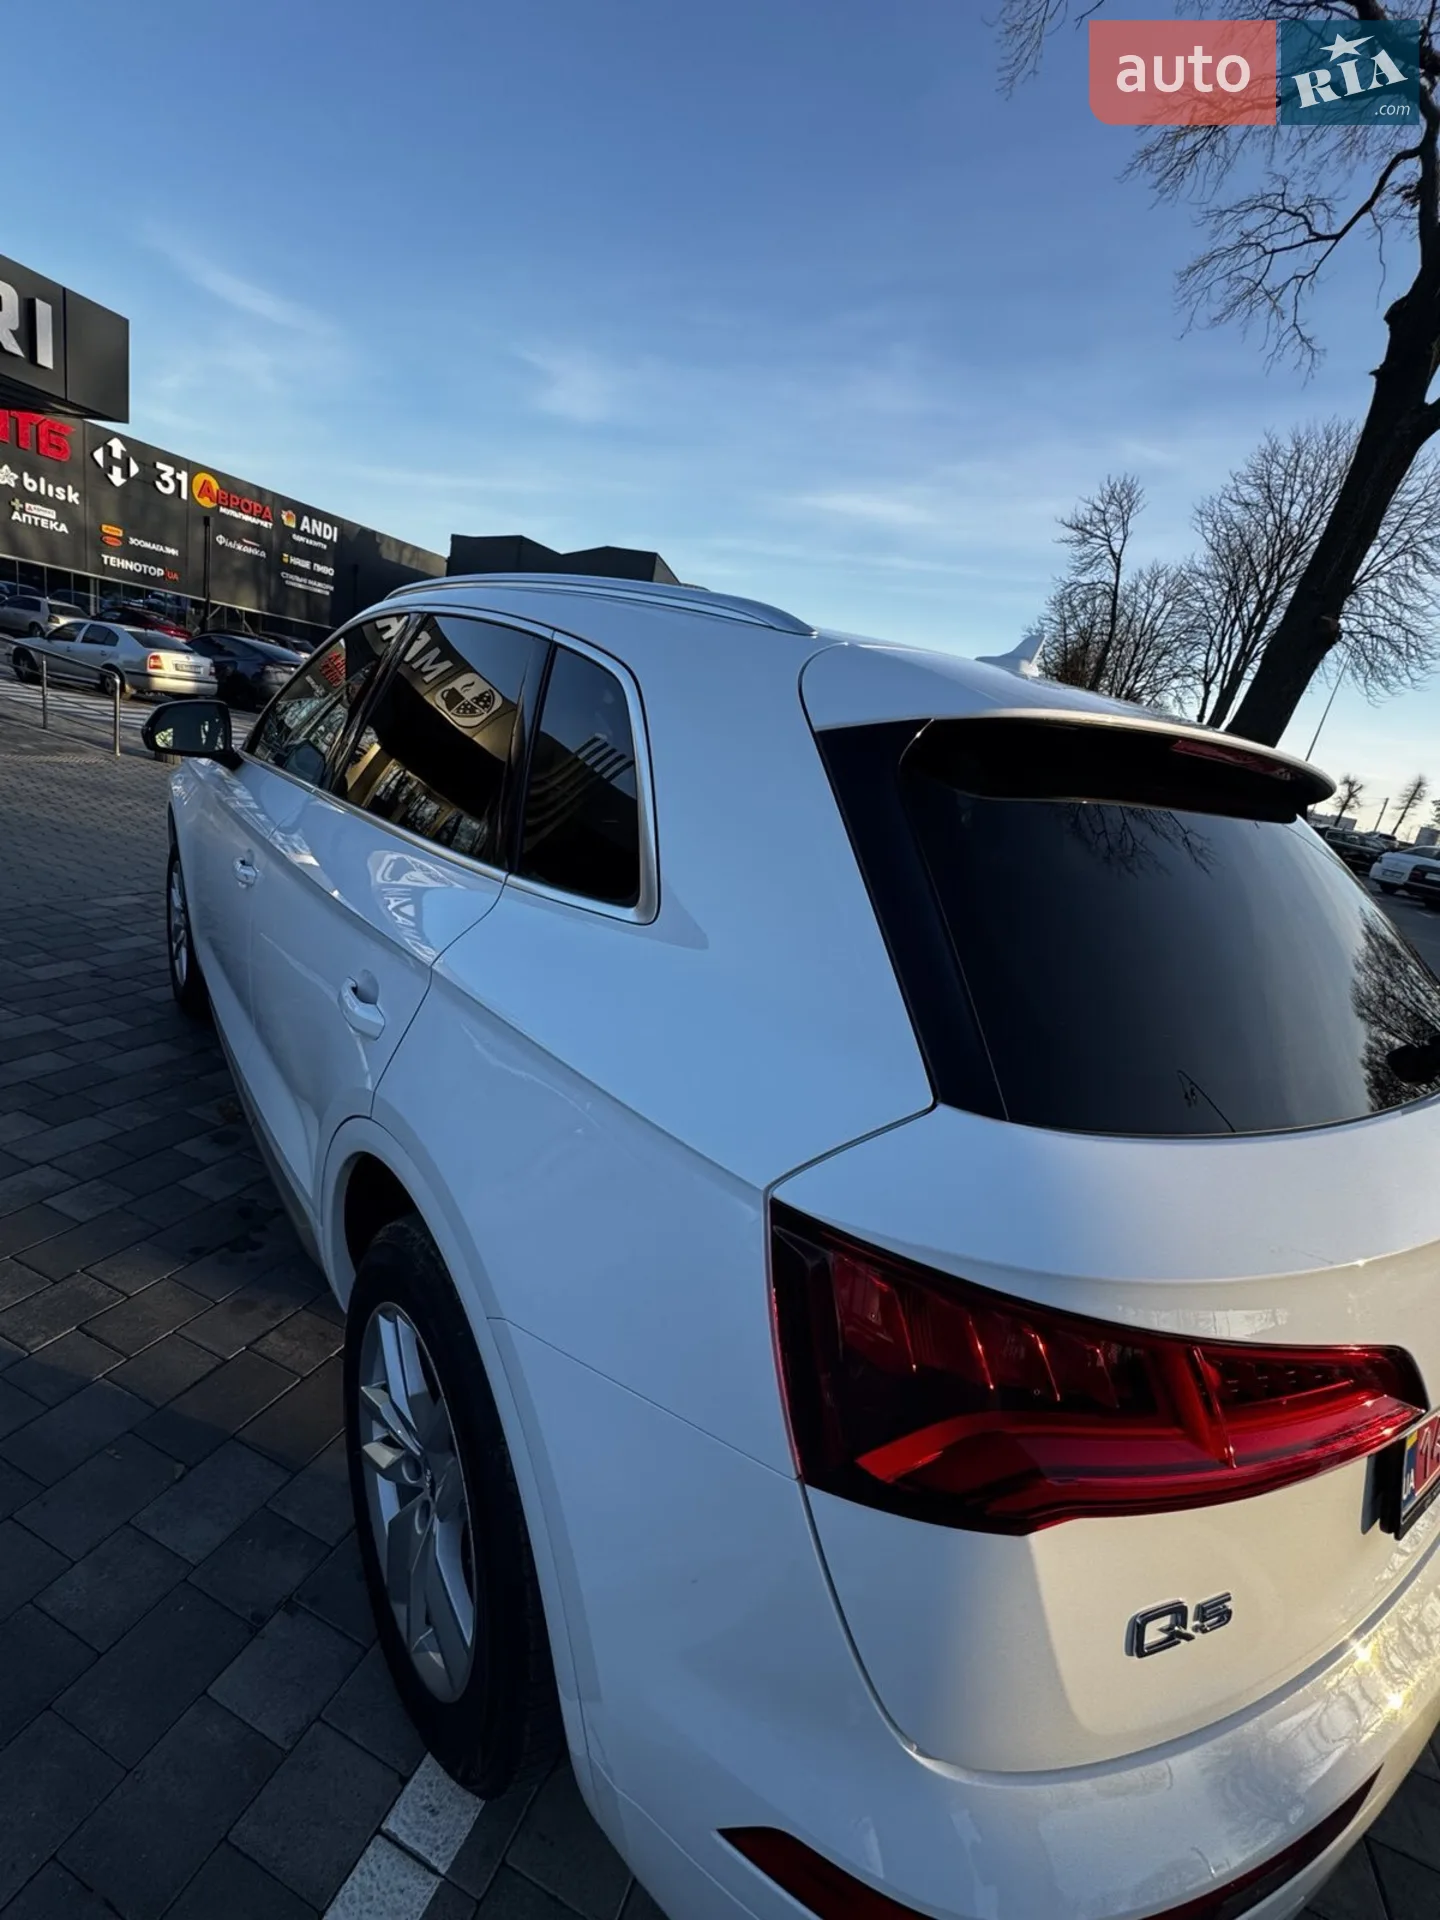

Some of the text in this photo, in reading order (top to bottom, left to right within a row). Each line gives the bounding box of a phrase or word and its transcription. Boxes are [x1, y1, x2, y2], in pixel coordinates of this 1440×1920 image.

[22, 471, 81, 505] blisk
[155, 461, 188, 500] 31
[197, 478, 273, 522] АВРОРА
[11, 510, 69, 534] АПТЕКА
[300, 515, 338, 543] ANDI
[128, 536, 179, 557] ЗООМАГАЗИН
[1403, 1467, 1415, 1501] UA
[1125, 1590, 1233, 1659] Q5
